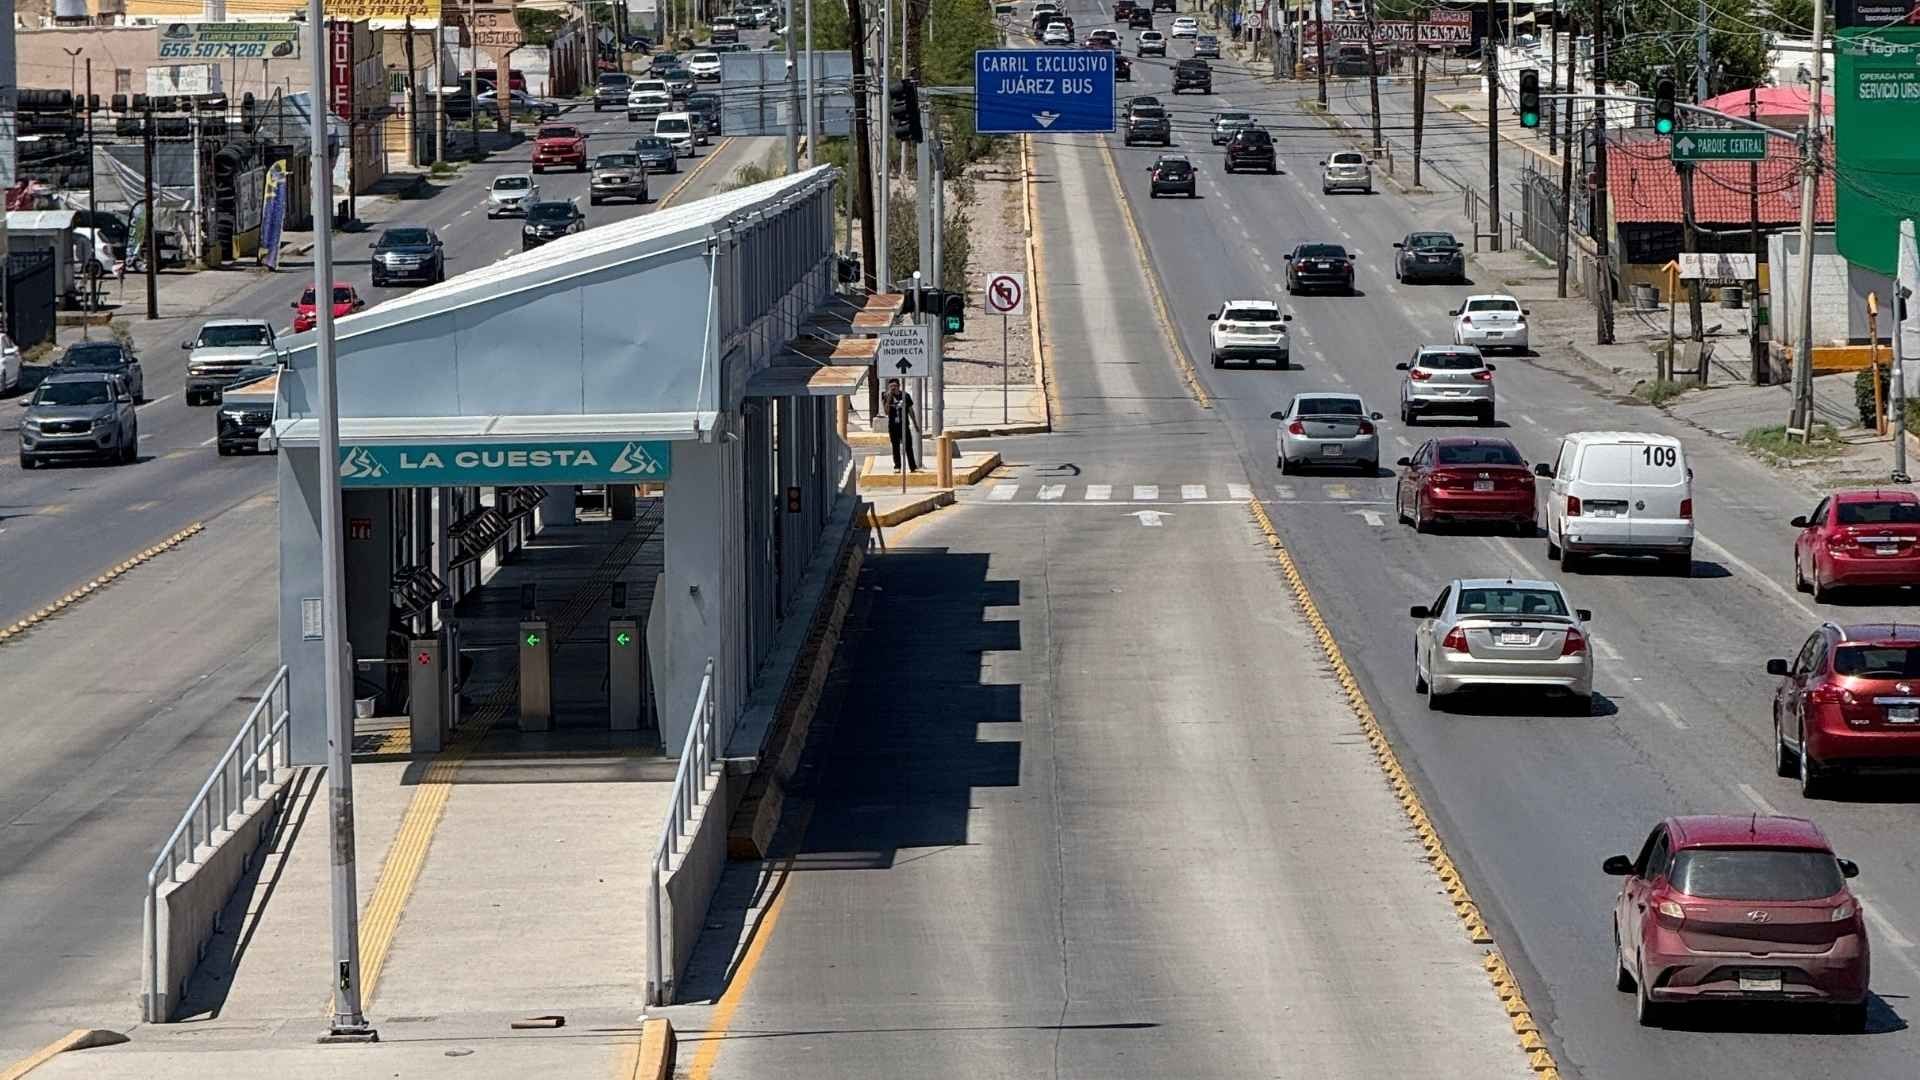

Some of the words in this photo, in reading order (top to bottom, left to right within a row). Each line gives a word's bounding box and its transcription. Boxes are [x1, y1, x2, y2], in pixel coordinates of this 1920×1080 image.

[1331, 23, 1375, 41] YONK
[1379, 23, 1472, 42] CONTNENTAL
[982, 56, 1029, 72] CARRIL
[1036, 56, 1107, 72] EXCLUSIVO
[1860, 72, 1896, 80] OPERADA
[1898, 72, 1915, 80] POR
[996, 75, 1055, 94] JUÁREZ
[1062, 78, 1093, 94] BUS
[1859, 82, 1899, 99] SERVICIO
[1697, 138, 1726, 153] PARQUE
[1730, 138, 1764, 153] CENTRAL
[889, 329, 919, 337] VUELTA
[882, 338, 925, 347] IZQUIERDA
[883, 347, 924, 355] INDIRECTA
[400, 452, 445, 469] LA
[455, 450, 598, 468] CUESTA
[1642, 446, 1677, 468] 109
